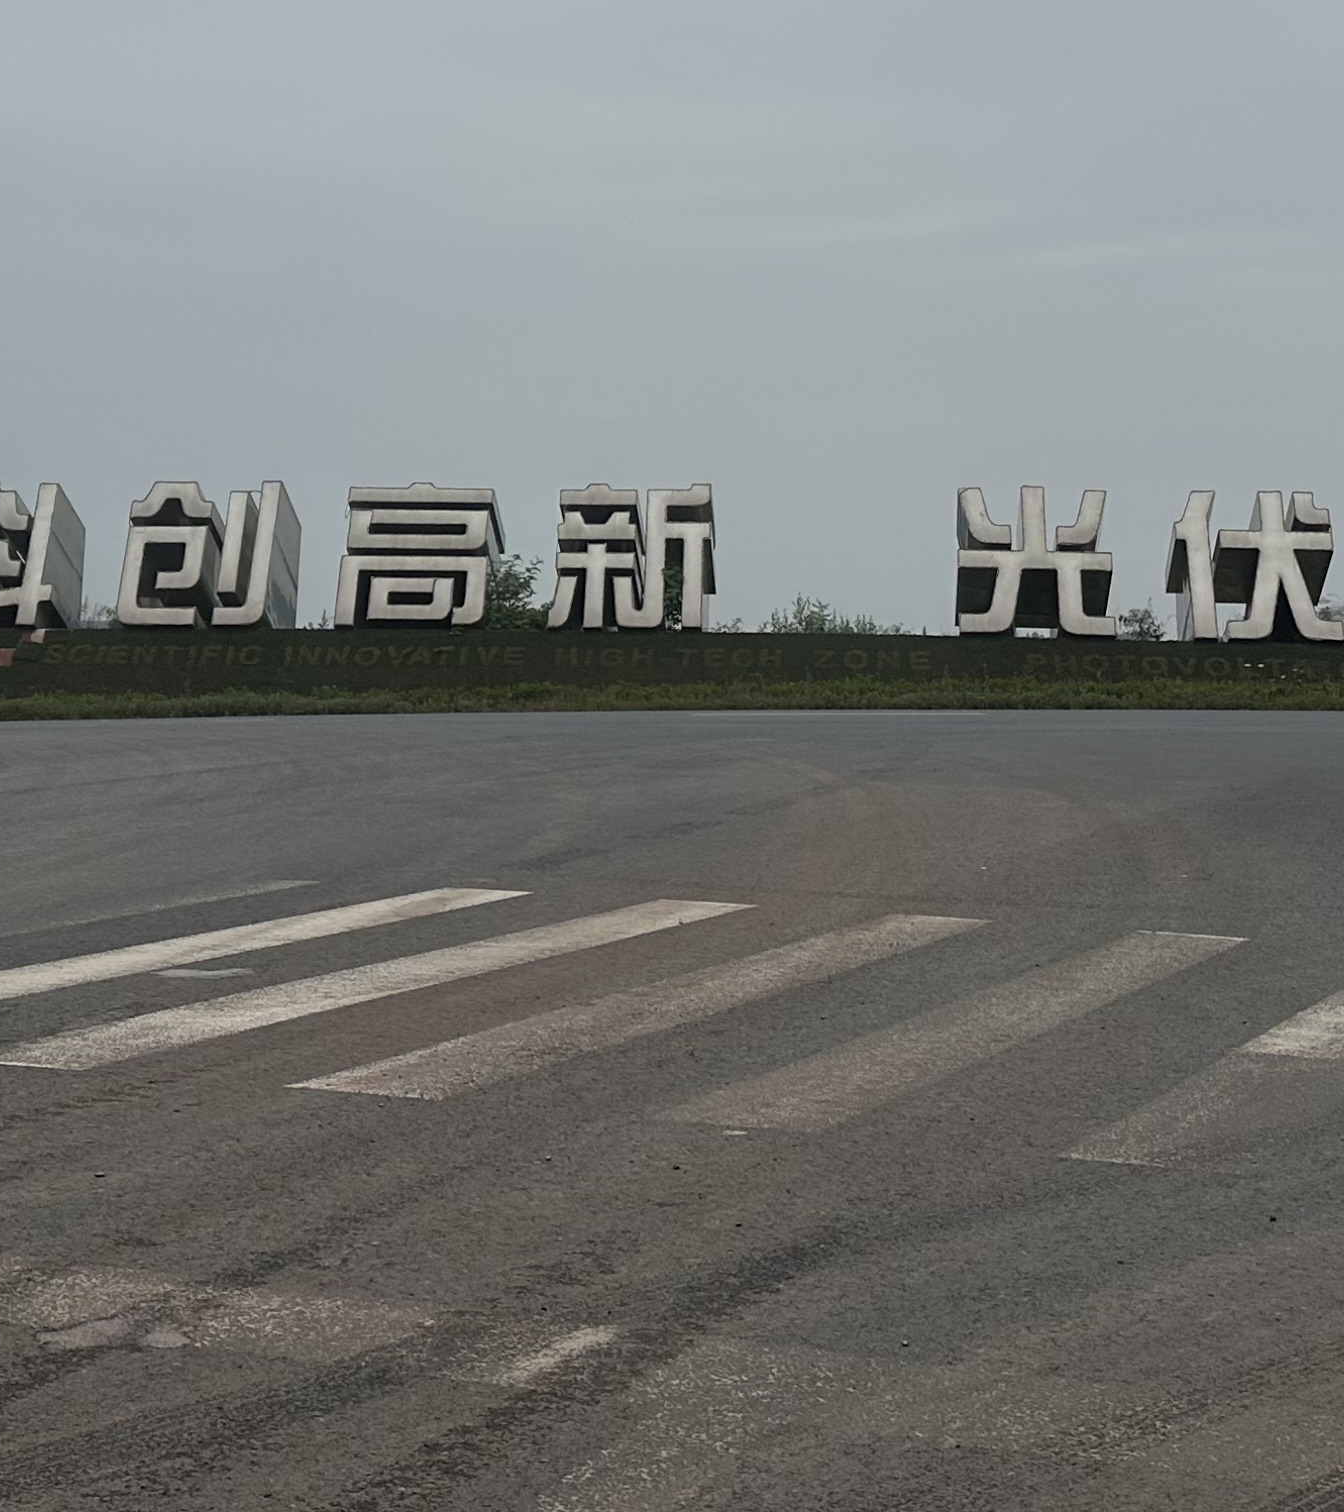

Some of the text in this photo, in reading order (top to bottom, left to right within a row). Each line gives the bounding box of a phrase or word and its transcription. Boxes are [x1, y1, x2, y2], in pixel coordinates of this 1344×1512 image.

[42, 643, 264, 666] SCIENTIFIC
[283, 644, 526, 667] INNOVATIVE
[814, 648, 931, 671] ZONE
